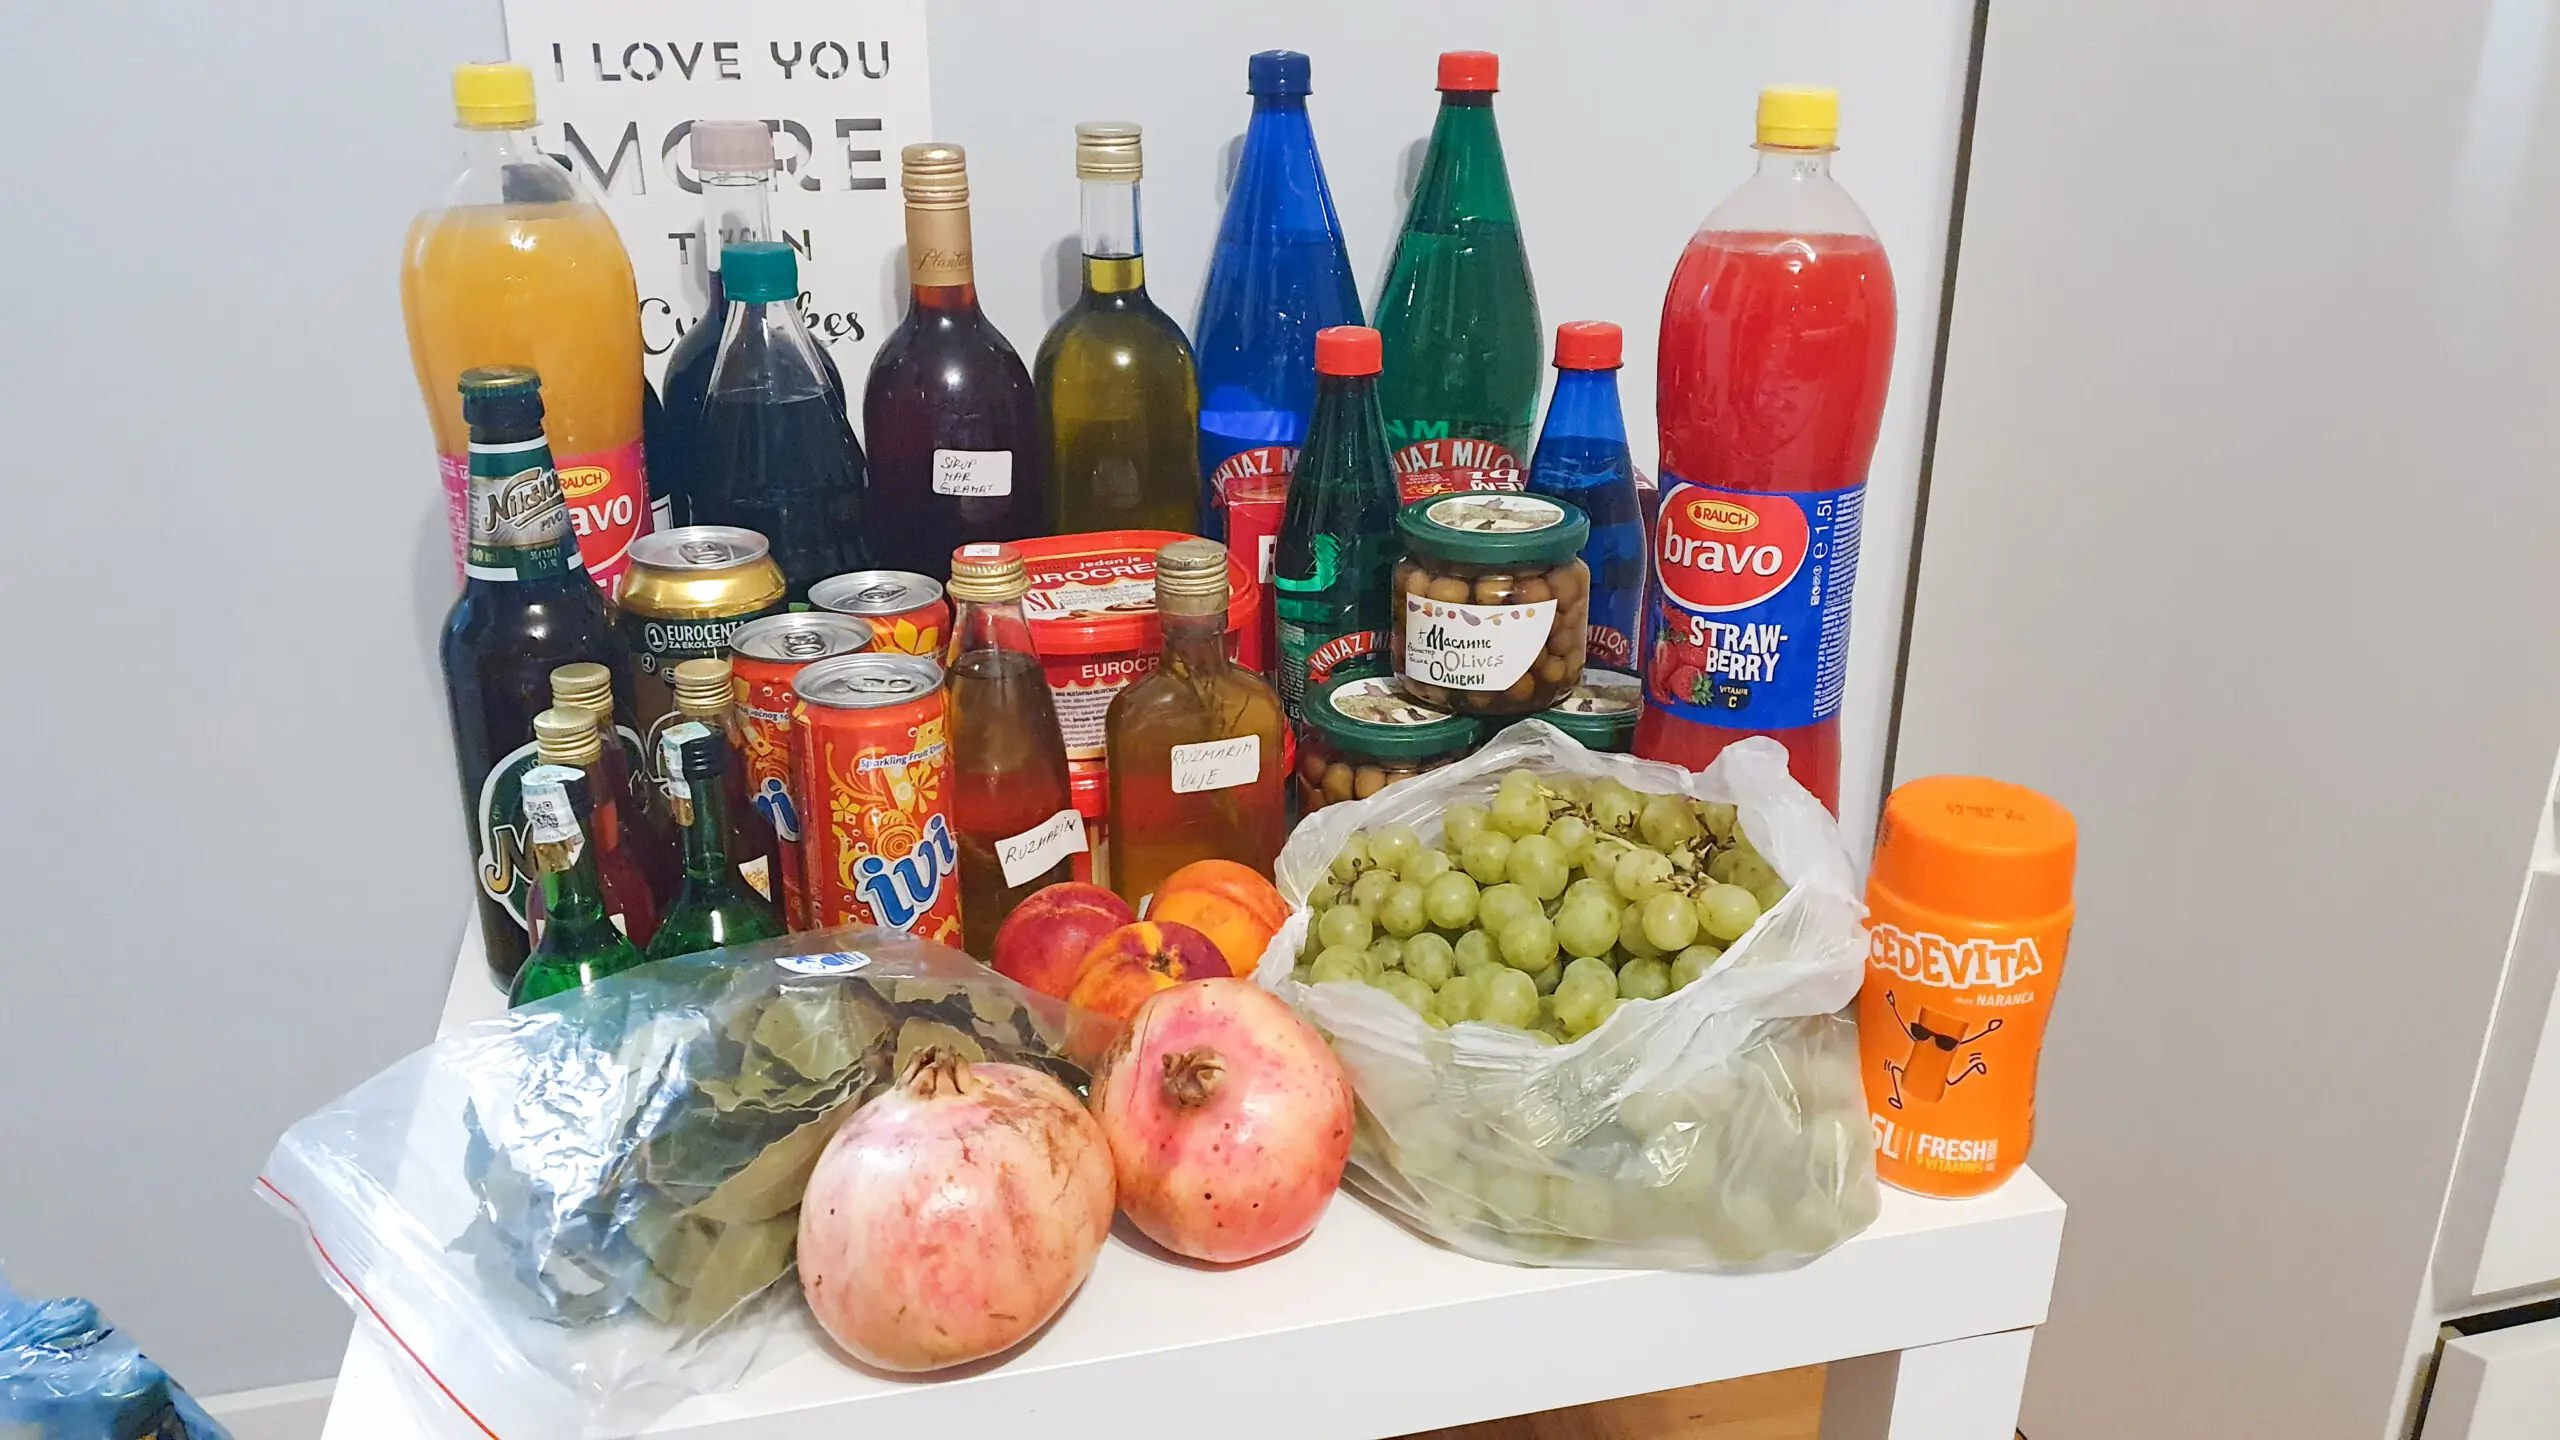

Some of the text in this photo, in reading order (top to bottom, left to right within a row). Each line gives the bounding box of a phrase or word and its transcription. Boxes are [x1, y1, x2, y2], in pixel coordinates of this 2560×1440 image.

[553, 41, 890, 81] I LOVE YOU
[1703, 507, 1749, 526] RAUCH
[1080, 558, 1124, 570] jedan
[1128, 556, 1142, 564] je
[1663, 518, 1783, 576] bravo
[1689, 616, 1788, 655] STRAW-
[1311, 635, 1364, 672] KNJAZ
[1706, 647, 1780, 682] BERRY
[1720, 685, 1748, 696] VITAMIN
[1728, 696, 1738, 708] C
[861, 756, 907, 768] Sparkling
[908, 748, 929, 760] Fruit
[861, 814, 955, 927] ivi
[1869, 923, 2043, 990] CEDEVITA
[1917, 1134, 1987, 1161] FRESH
